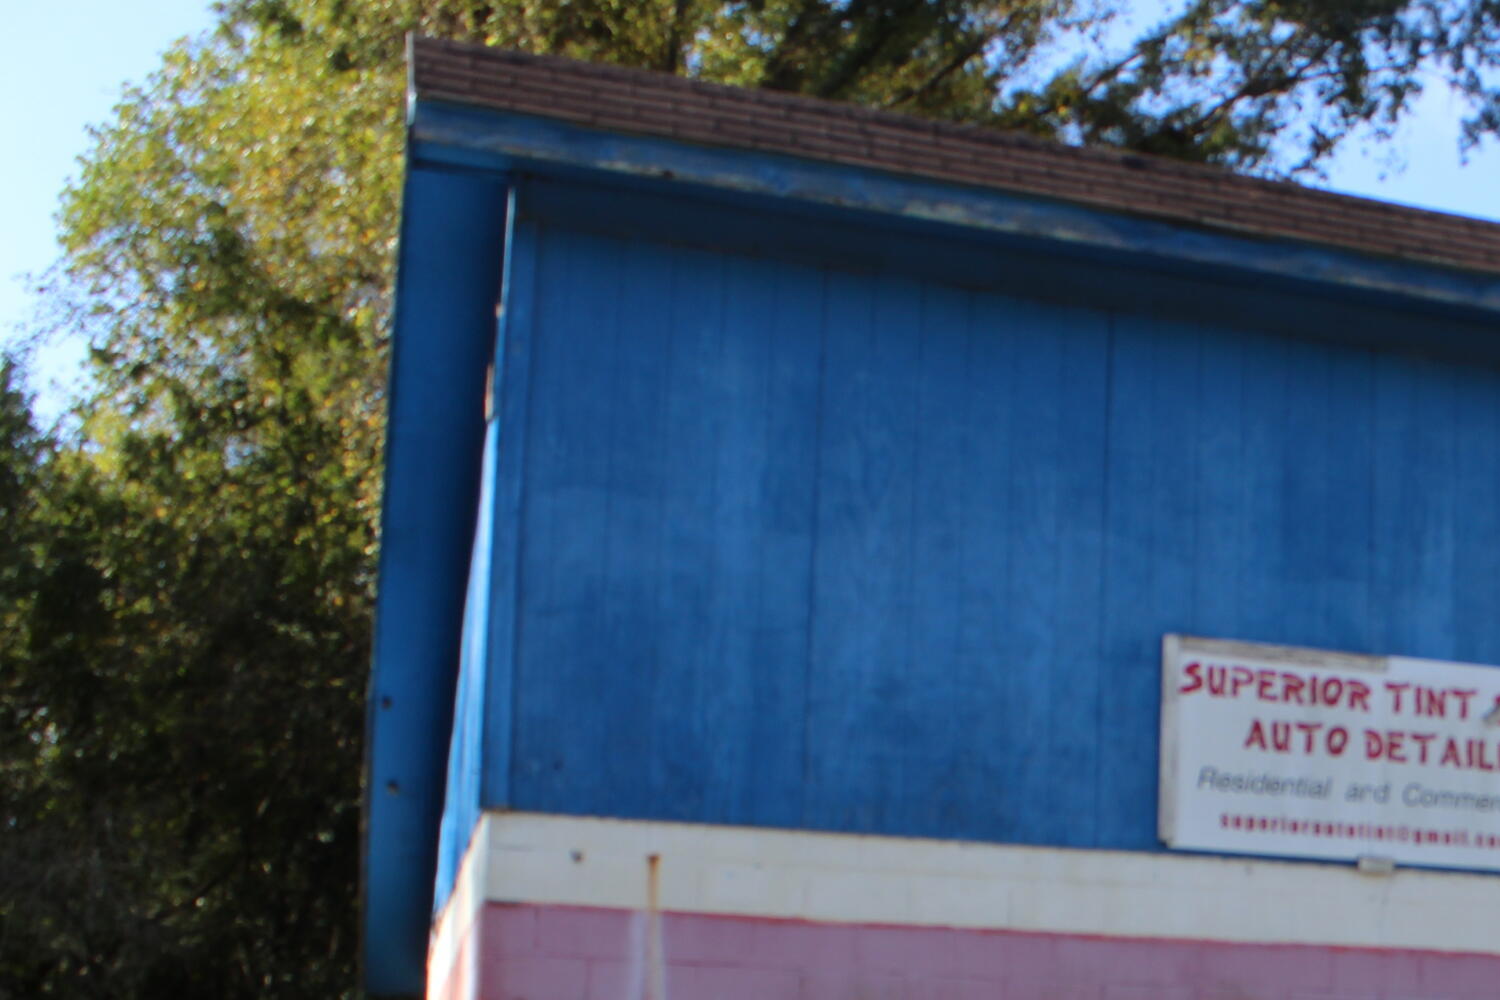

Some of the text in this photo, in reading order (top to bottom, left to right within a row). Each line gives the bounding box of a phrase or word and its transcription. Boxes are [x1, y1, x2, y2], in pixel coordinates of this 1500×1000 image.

[1180, 662, 1371, 712] SUPERIOR
[1386, 683, 1478, 720] TINT
[1244, 720, 1348, 756] AUTO
[1197, 766, 1332, 799] Residential
[1345, 784, 1391, 804] and
